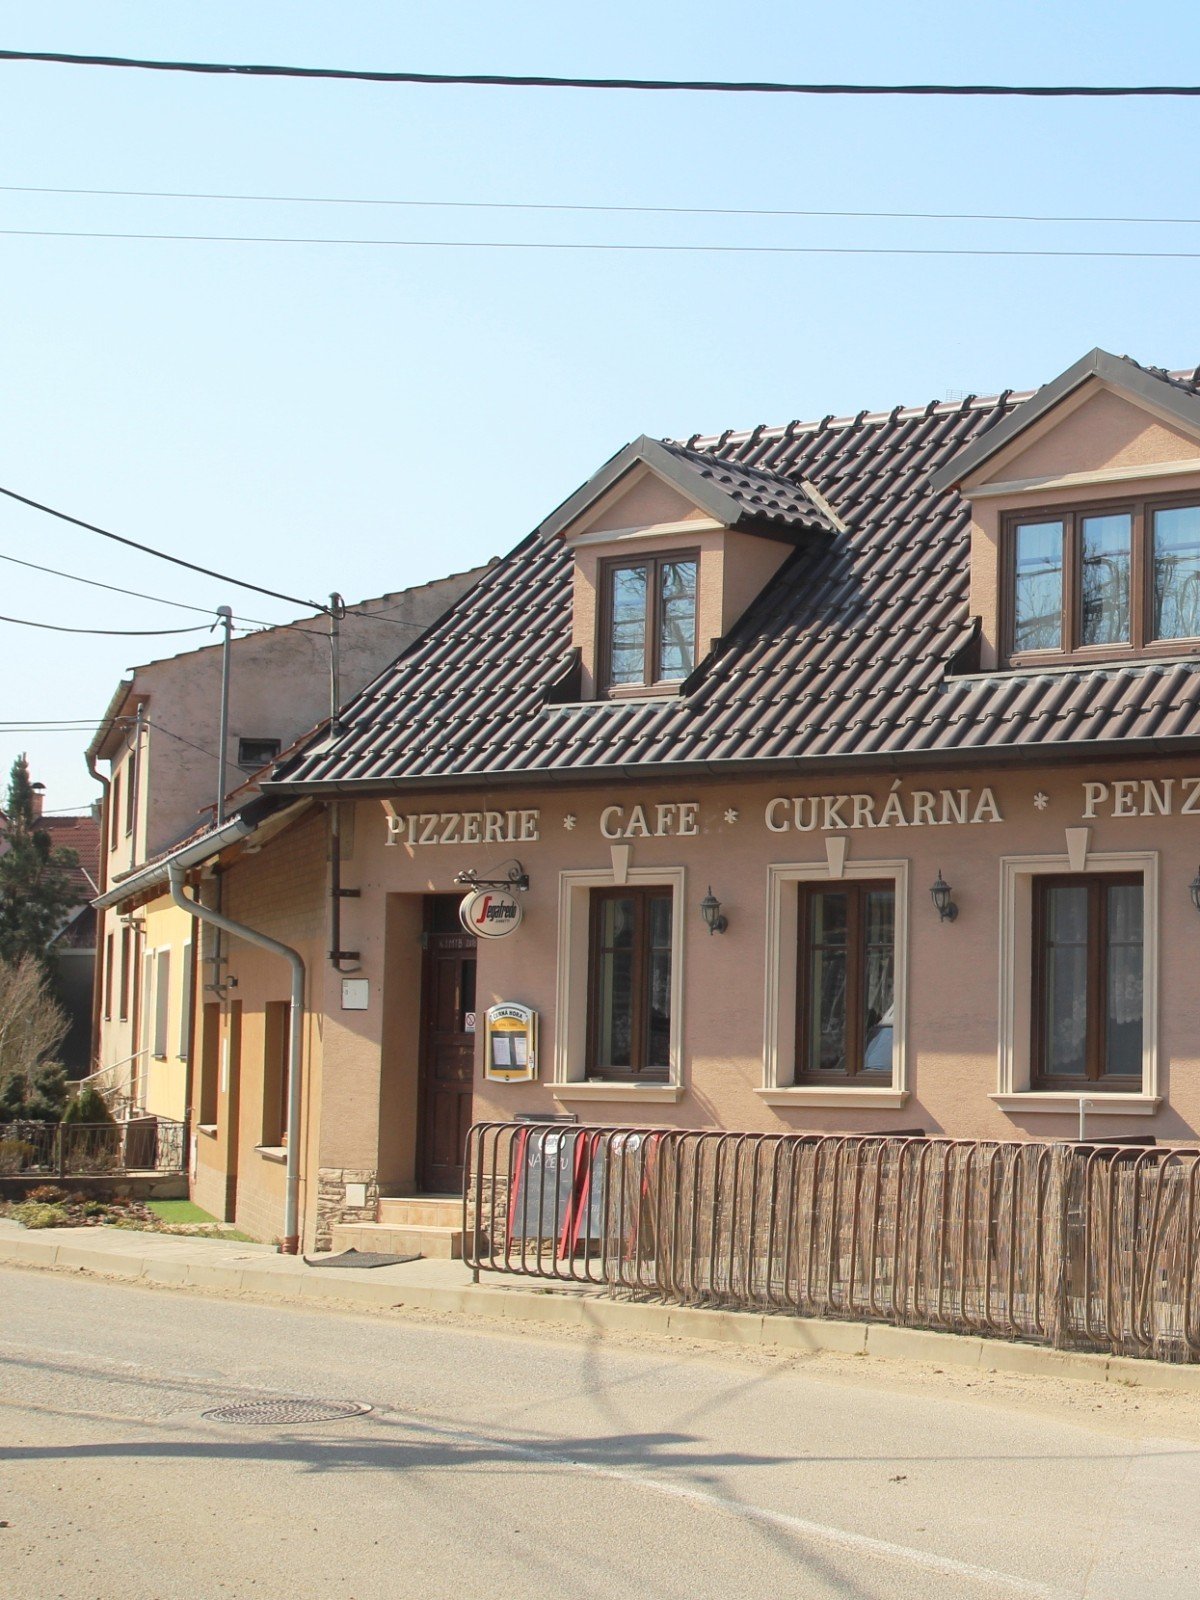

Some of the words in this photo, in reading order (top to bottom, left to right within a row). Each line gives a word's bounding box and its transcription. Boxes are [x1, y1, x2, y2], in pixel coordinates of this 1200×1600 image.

[384, 808, 541, 846] PIZZERIE
[599, 802, 701, 839] CAFE
[764, 778, 1004, 833] CUKRÁRNA
[476, 896, 517, 923] Segafredo
[544, 1155, 569, 1170] ČEU
